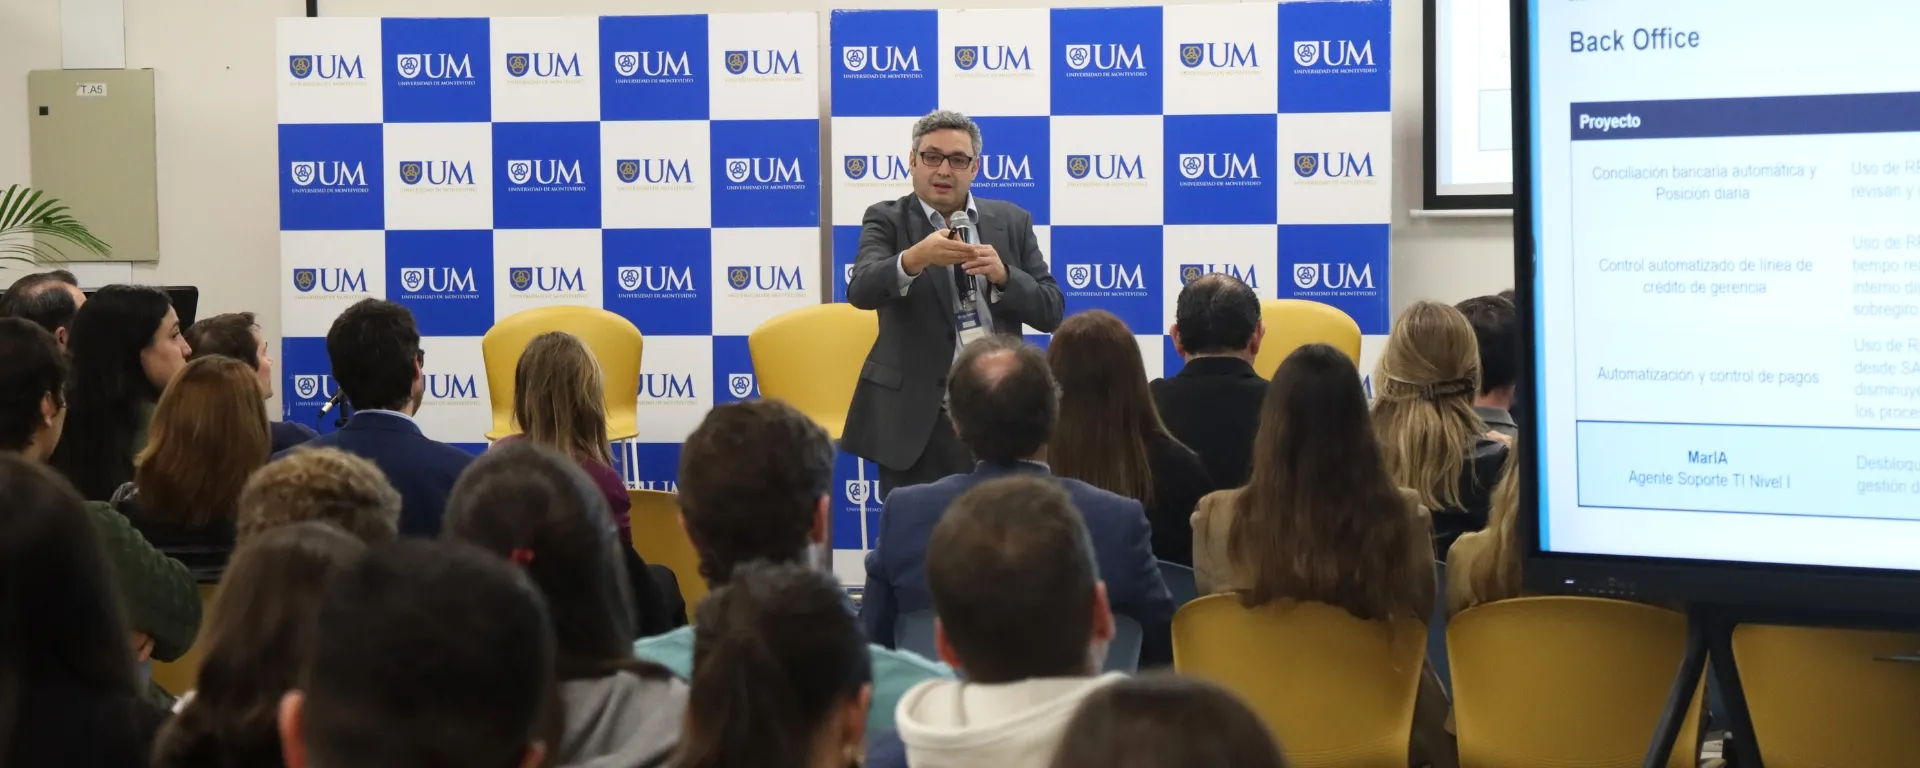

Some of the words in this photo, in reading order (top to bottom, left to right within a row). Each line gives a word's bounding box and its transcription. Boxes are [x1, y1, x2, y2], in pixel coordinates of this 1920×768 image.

[1570, 30, 1624, 52] Back
[1633, 27, 1700, 50] Office
[532, 52, 583, 77] UM
[642, 51, 693, 76] UM
[751, 50, 802, 75] UM
[871, 46, 921, 71] UM
[981, 45, 1033, 71] UM
[1094, 44, 1145, 69] UM
[1207, 42, 1260, 68] UM
[1322, 40, 1376, 66] UM
[316, 55, 366, 79] UM
[424, 54, 474, 78] UM
[80, 84, 102, 94] T.A5
[1579, 113, 1641, 132] Proyecto
[318, 161, 368, 185] UM
[426, 160, 476, 184] UM
[535, 160, 584, 184] UM
[643, 159, 695, 183] UM
[753, 158, 804, 182] UM
[982, 155, 1034, 180] UM
[1094, 154, 1146, 179] UM
[1208, 153, 1260, 178] UM
[1322, 152, 1375, 177] UM
[1592, 166, 1668, 180] Conciliación
[1672, 165, 1728, 178] bancaria
[1809, 166, 1817, 180] y
[1656, 186, 1710, 200] Posición
[1714, 186, 1750, 200] diaria
[1095, 264, 1146, 289] UM
[1323, 263, 1376, 288] UM
[1599, 258, 1644, 272] Control
[1648, 259, 1735, 272] automatizado
[1739, 258, 1755, 272] de
[1796, 258, 1813, 272] de
[320, 268, 369, 292] UM
[428, 268, 478, 292] UM
[536, 267, 586, 291] UM
[645, 267, 695, 291] UM
[754, 266, 805, 290] UM
[1643, 280, 1686, 294] crédito
[1690, 280, 1706, 294] de
[1710, 281, 1767, 296] gerencia
[429, 374, 478, 398] UM
[646, 373, 696, 398] UM
[1598, 366, 1694, 382] Automatización
[1699, 371, 1706, 384] y
[1710, 370, 1753, 382] control
[1758, 370, 1774, 383] de
[1778, 372, 1820, 386] pagos
[1628, 470, 1674, 486] Agente
[1678, 472, 1728, 488] Soporte
[1750, 474, 1782, 488] Nivel
